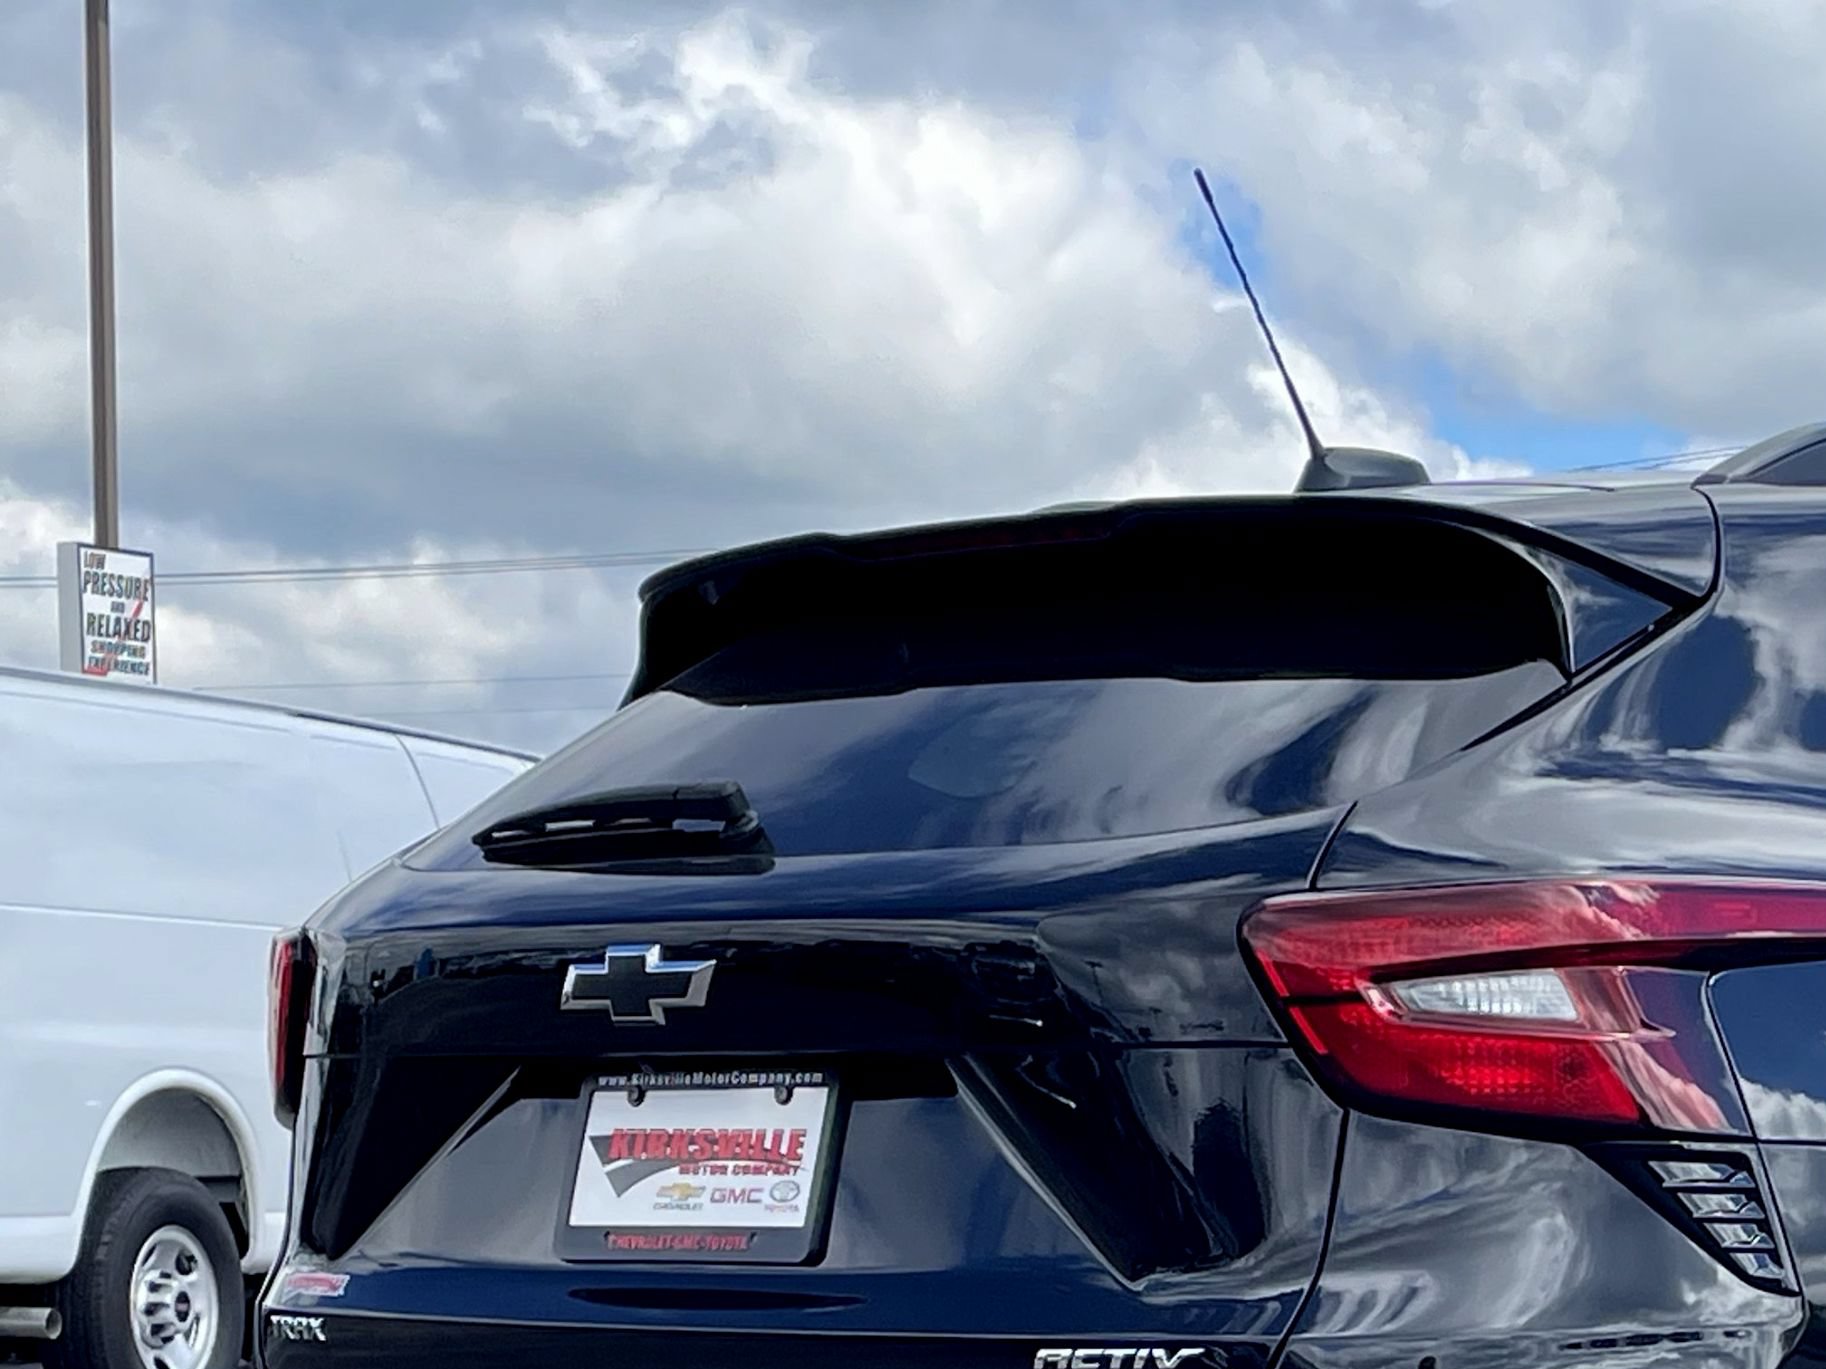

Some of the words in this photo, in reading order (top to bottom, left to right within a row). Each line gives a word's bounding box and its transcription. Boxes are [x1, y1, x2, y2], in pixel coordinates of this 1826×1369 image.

[84, 551, 106, 569] LOW
[83, 571, 150, 601] PRESSURE
[110, 601, 125, 613] AND
[86, 613, 151, 642] RELAXED
[91, 641, 146, 659] SHOPPING
[88, 656, 150, 676] EXPERIENCE
[607, 1128, 807, 1161] KIRKSVILLE
[679, 1164, 728, 1175] MOTOR
[731, 1163, 801, 1176] COMPANY
[710, 1187, 763, 1204] GMC
[270, 1315, 326, 1341] TRAX
[1033, 1348, 1205, 1369] ACTIV
